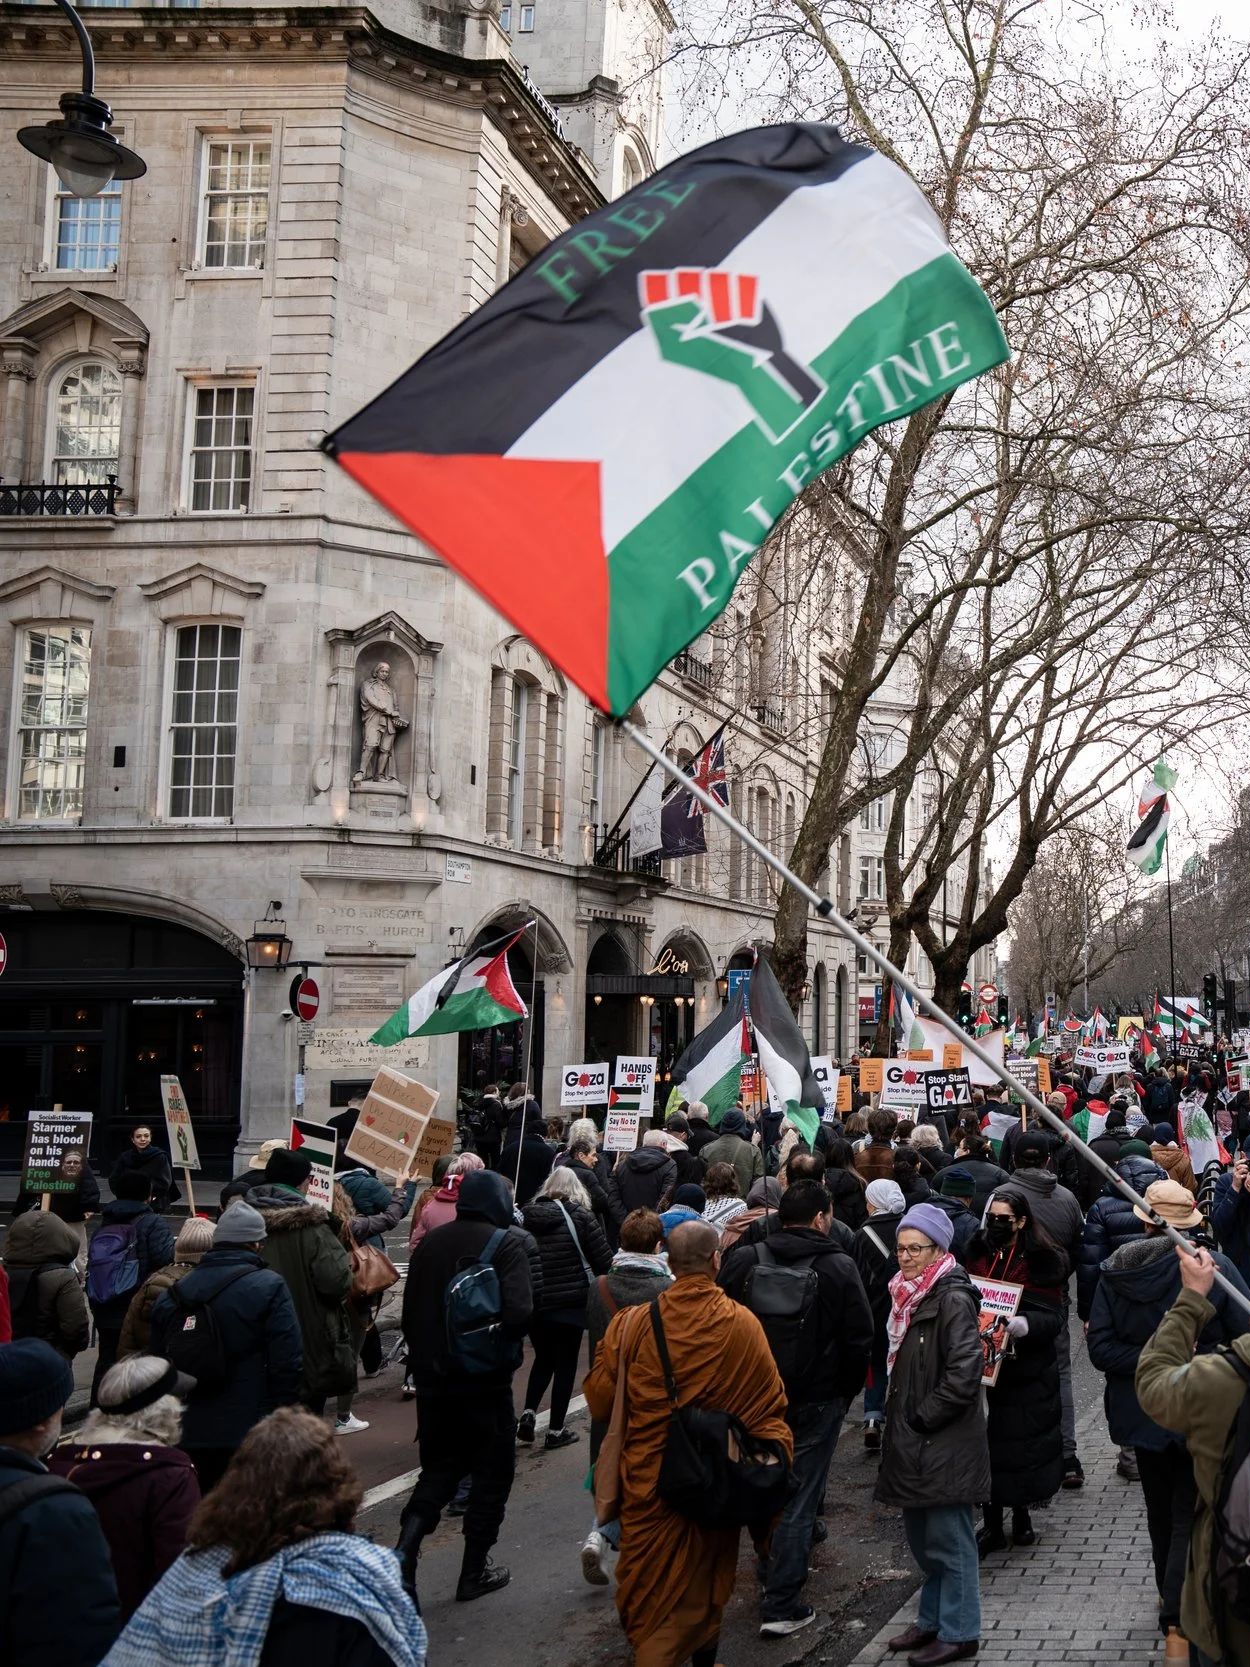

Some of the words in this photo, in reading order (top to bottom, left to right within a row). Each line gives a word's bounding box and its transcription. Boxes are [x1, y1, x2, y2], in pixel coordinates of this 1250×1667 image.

[534, 180, 697, 303] FREE
[447, 859, 471, 871] SOUTHAMPTON
[317, 924, 368, 935] BAPTIS
[1097, 1051, 1126, 1062] Gza
[1180, 1048, 1198, 1057] GAZA
[621, 1063, 652, 1073] HANDS
[565, 1071, 604, 1087] Gza
[928, 1076, 946, 1085] Stop
[388, 1109, 418, 1133] LOVE
[609, 1117, 619, 1126] Say
[33, 1122, 76, 1132] Starmer
[31, 1134, 49, 1144] has
[53, 1134, 84, 1144] blood
[30, 1147, 42, 1155] on
[46, 1145, 62, 1155] his
[28, 1157, 60, 1167] hands
[27, 1168, 50, 1178] Free
[25, 1180, 75, 1190] Palestine
[321, 1178, 329, 1189] to
[982, 1301, 1013, 1312] COMPLICITY
